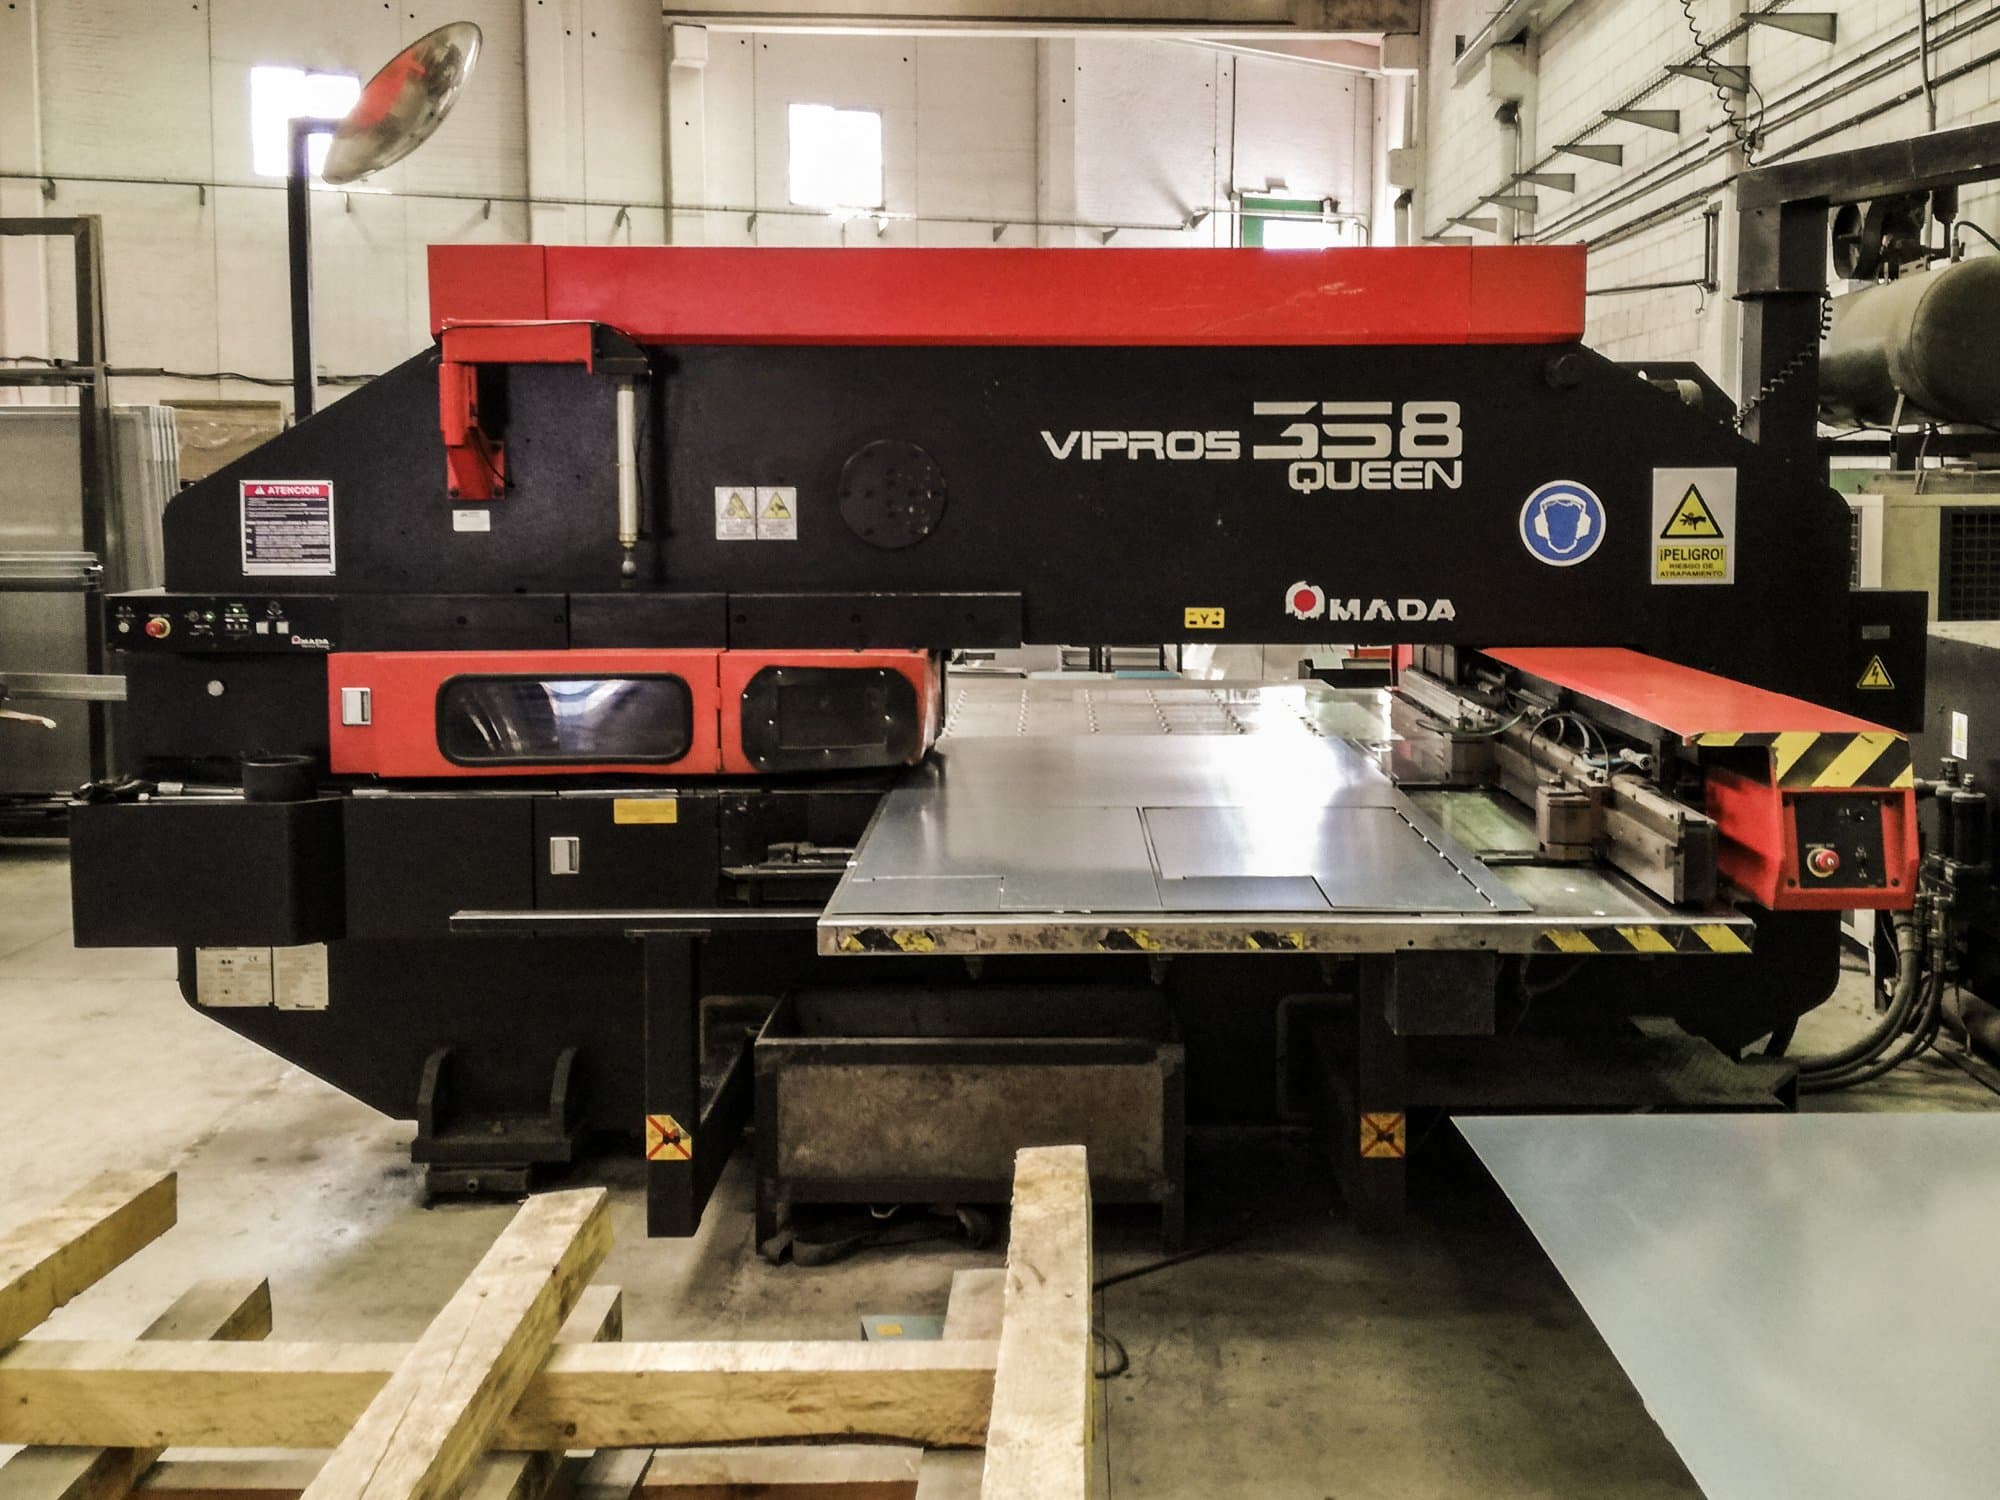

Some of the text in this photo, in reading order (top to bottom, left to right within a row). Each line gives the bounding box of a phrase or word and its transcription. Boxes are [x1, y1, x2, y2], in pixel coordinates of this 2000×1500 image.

[1040, 401, 1463, 461] VIPROS 358
[1288, 461, 1463, 494] QUEEN
[267, 486, 320, 495] ATENCION
[1660, 548, 1724, 561] ¡PELIGRO!
